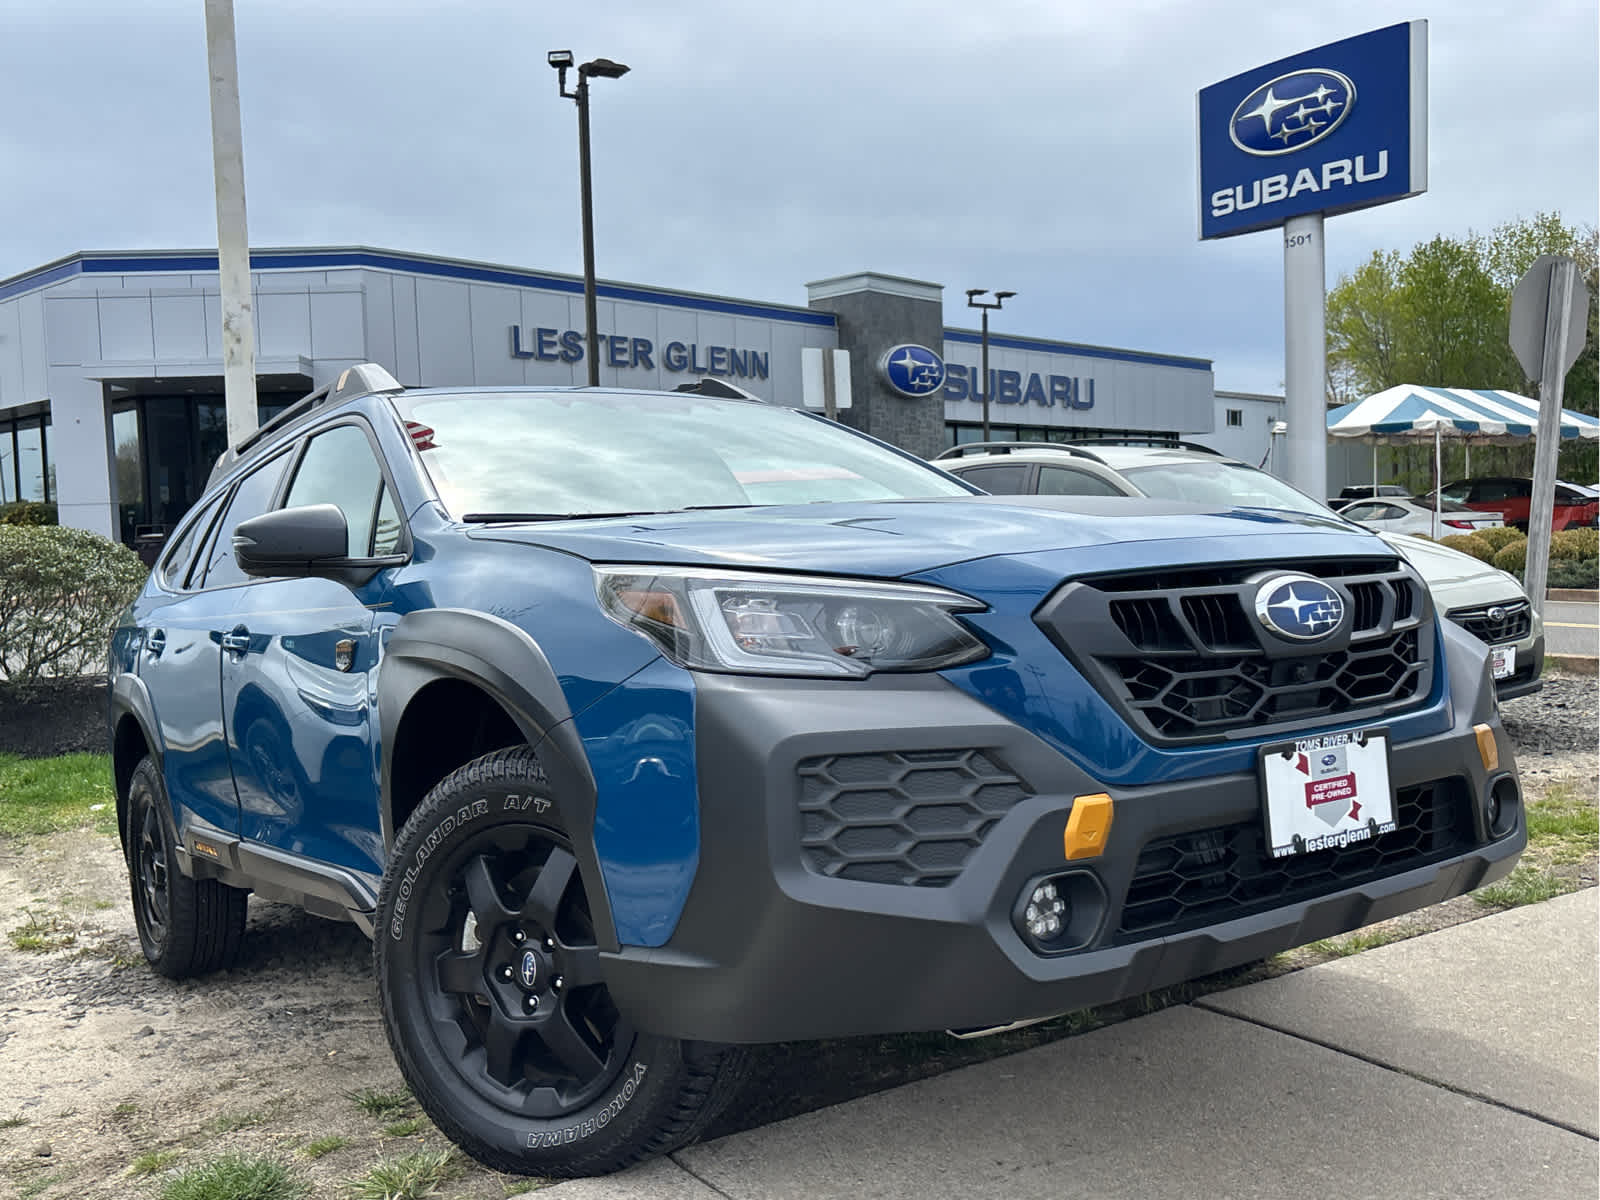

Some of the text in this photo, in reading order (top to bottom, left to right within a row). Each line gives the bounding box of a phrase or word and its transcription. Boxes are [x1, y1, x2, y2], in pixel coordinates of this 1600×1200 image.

[1211, 150, 1388, 217] SUBARU
[1284, 233, 1313, 249] 1501
[664, 341, 770, 379] GLENN
[943, 363, 1096, 411] SUBARU
[1295, 738, 1321, 752] TOMS
[1353, 731, 1364, 743] NJ
[1311, 787, 1352, 802] PRE-OWNED
[1313, 779, 1348, 793] CERTIFIED
[391, 794, 552, 940] GEOLANDAR A/T
[526, 1061, 649, 1149] YOKOHAMA
